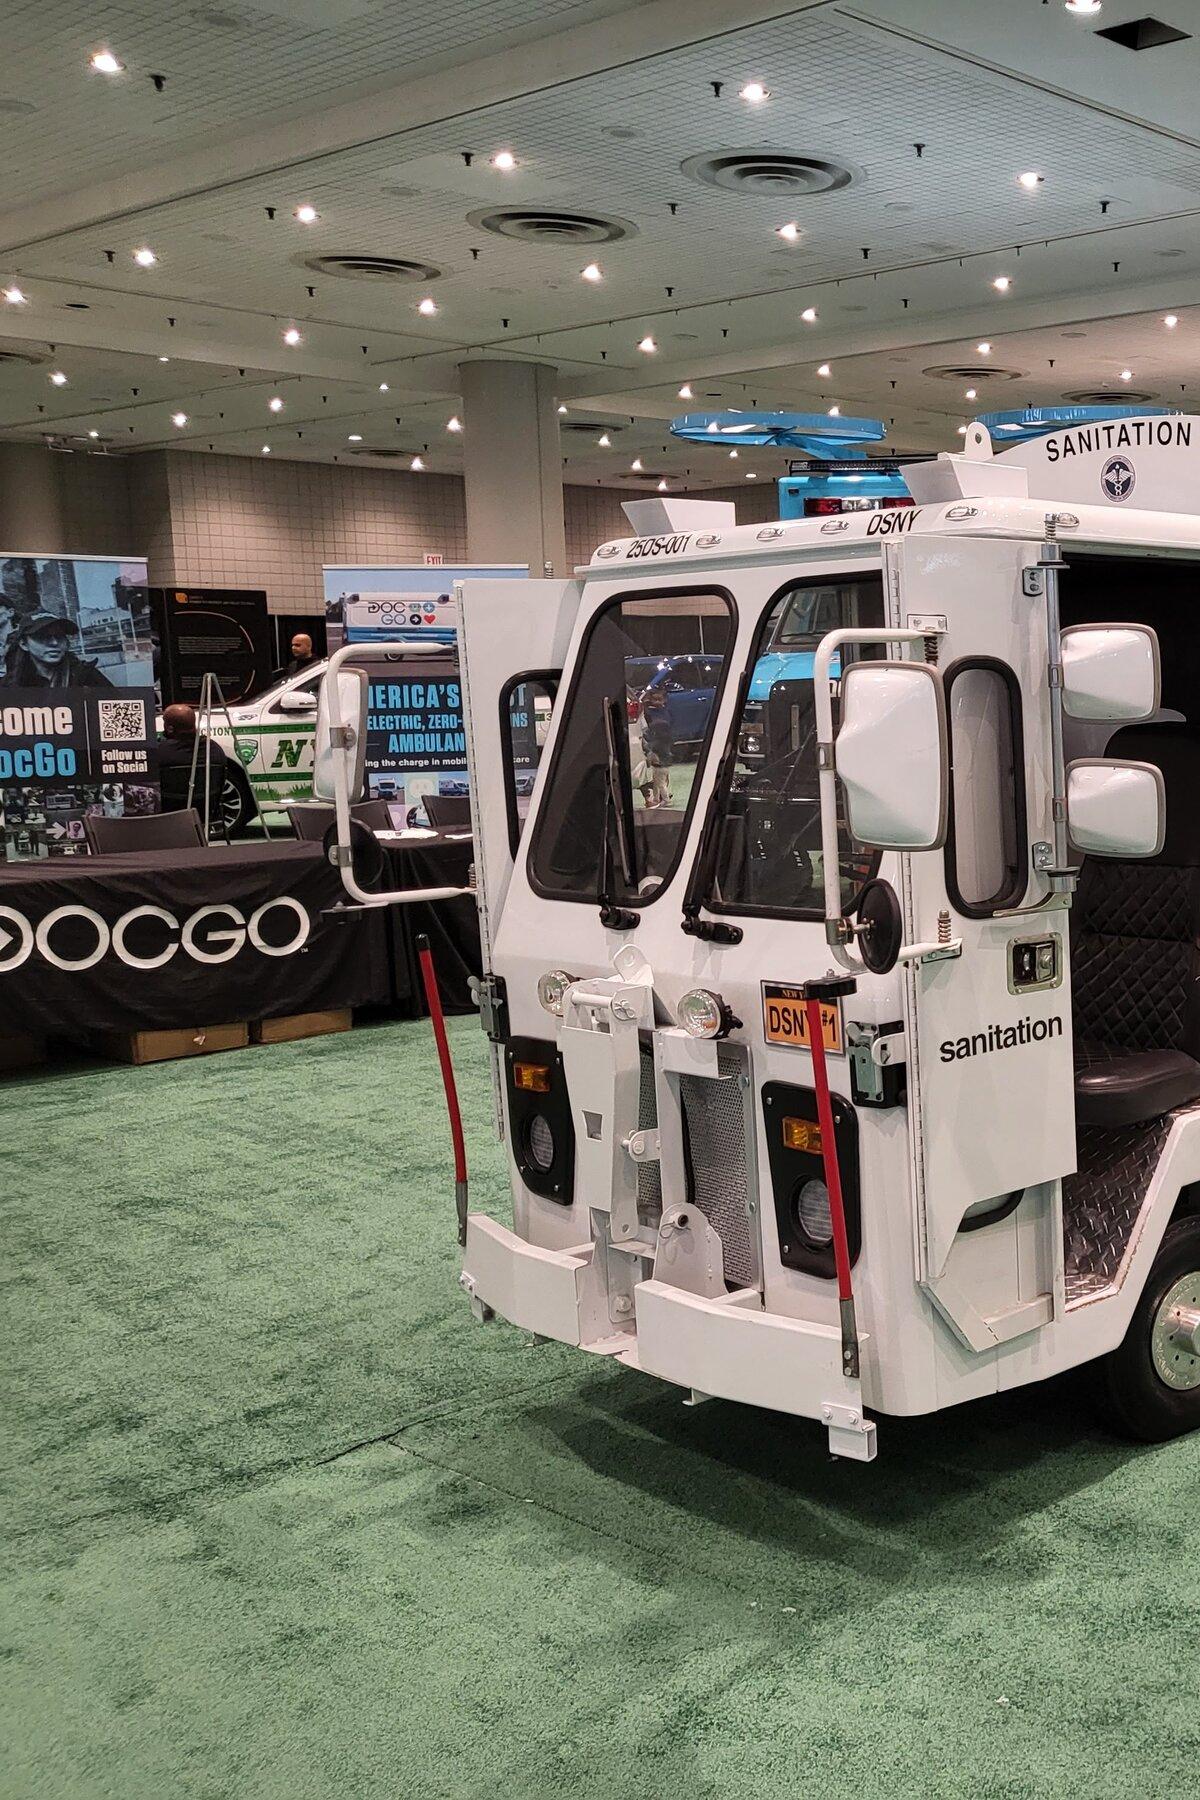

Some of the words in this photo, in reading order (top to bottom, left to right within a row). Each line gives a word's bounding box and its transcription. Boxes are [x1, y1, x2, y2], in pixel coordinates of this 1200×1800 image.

[1046, 421, 1191, 462] SANITATION
[866, 509, 921, 536] DSNY
[626, 533, 692, 559] 25DS-001
[426, 555, 442, 565] EXIT
[381, 614, 406, 625] GO
[368, 684, 460, 710] ERICA'S
[0, 707, 74, 736] ome
[428, 714, 465, 730] ZERO-
[101, 750, 132, 761] Follow
[135, 750, 147, 760] us
[381, 758, 396, 767] the
[398, 759, 430, 769] charge
[432, 757, 441, 766] in
[442, 758, 467, 766] mobil
[102, 764, 115, 774] on
[117, 761, 148, 773] Social
[782, 989, 798, 998] NEW
[940, 1016, 1063, 1063] sanitation
